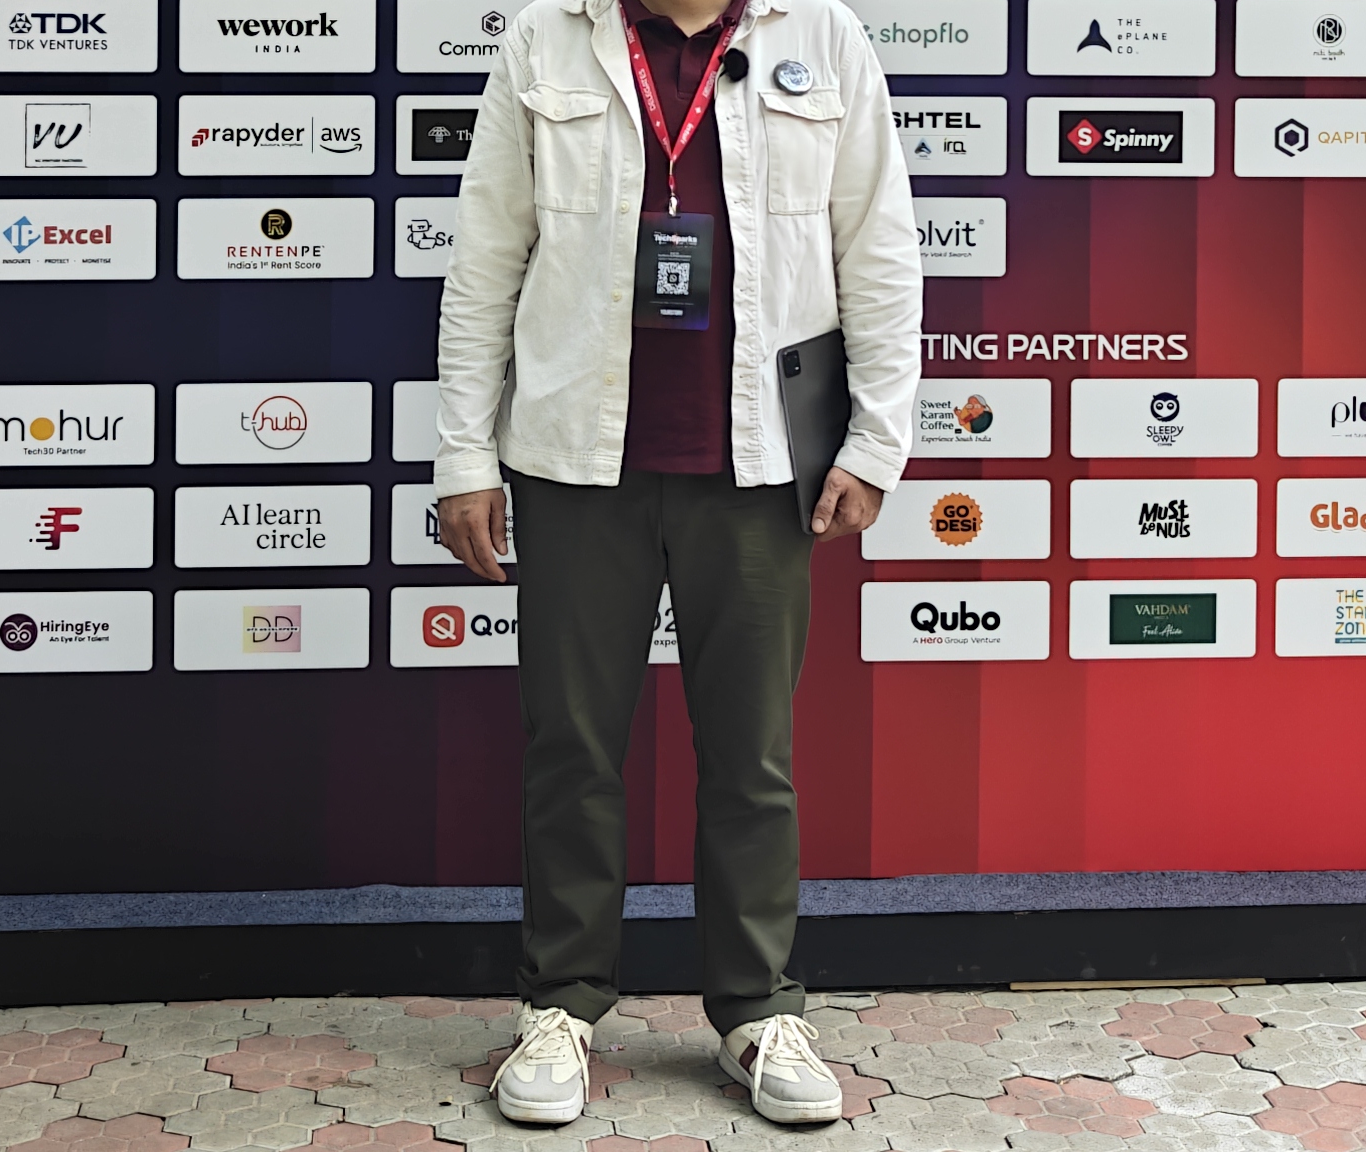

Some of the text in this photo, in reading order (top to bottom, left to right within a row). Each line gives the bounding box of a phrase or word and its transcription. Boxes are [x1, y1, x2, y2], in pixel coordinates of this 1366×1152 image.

[31, 12, 107, 34] TDK
[217, 12, 339, 37] wework
[1117, 18, 1142, 27] THE
[879, 22, 969, 49] shopflo
[9, 38, 108, 50] TDK VENTURES
[255, 44, 302, 54] INDIA
[211, 122, 305, 148] rapyder
[321, 126, 361, 142] aws
[1103, 129, 1174, 152] Spinny
[227, 246, 323, 258] RENTENPE
[227, 261, 257, 270] India's
[271, 261, 293, 269] Rent
[294, 261, 321, 269] Score
[920, 400, 951, 409] Sweet
[921, 410, 955, 420] Karam
[920, 421, 955, 430] Coffee
[1147, 426, 1184, 438] SLEEPY
[1153, 434, 1176, 442] OWL
[23, 447, 87, 456] Tech30 Partner
[221, 503, 322, 526] AI learn
[943, 504, 969, 518] GO
[256, 528, 326, 550] circle
[1335, 590, 1364, 603] THE
[1135, 604, 1189, 616] VAHDAM
[910, 600, 1001, 634] Qubo
[40, 620, 109, 635] HiringEye
